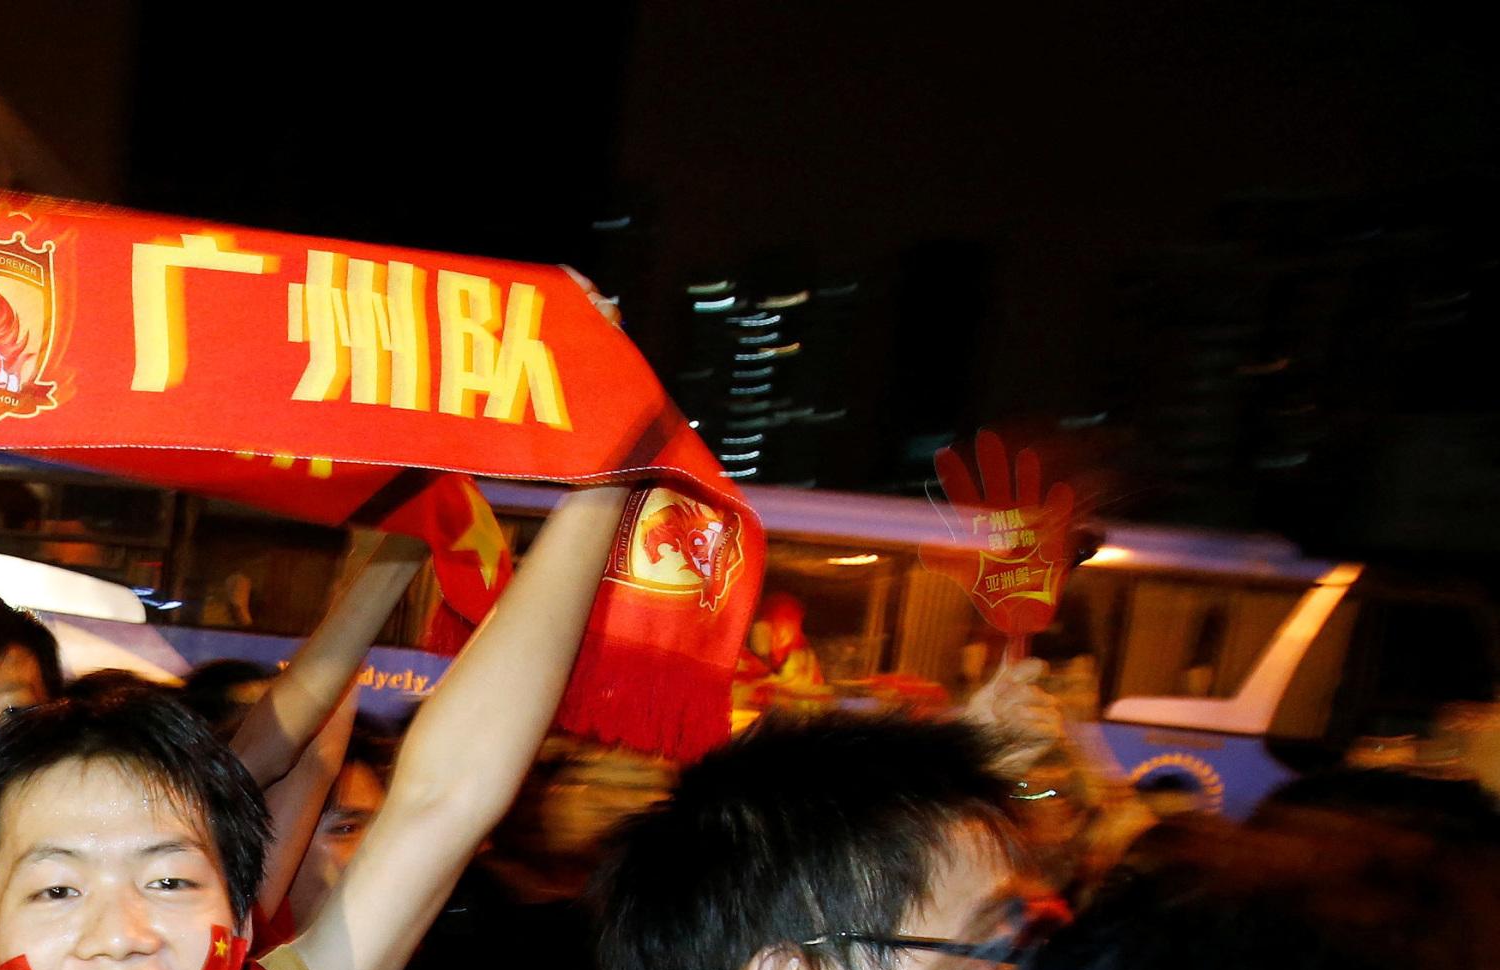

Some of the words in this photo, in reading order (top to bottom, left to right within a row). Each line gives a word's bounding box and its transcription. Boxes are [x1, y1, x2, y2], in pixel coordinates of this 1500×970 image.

[130, 233, 573, 431] 广州队
[972, 508, 1026, 535] 广州队
